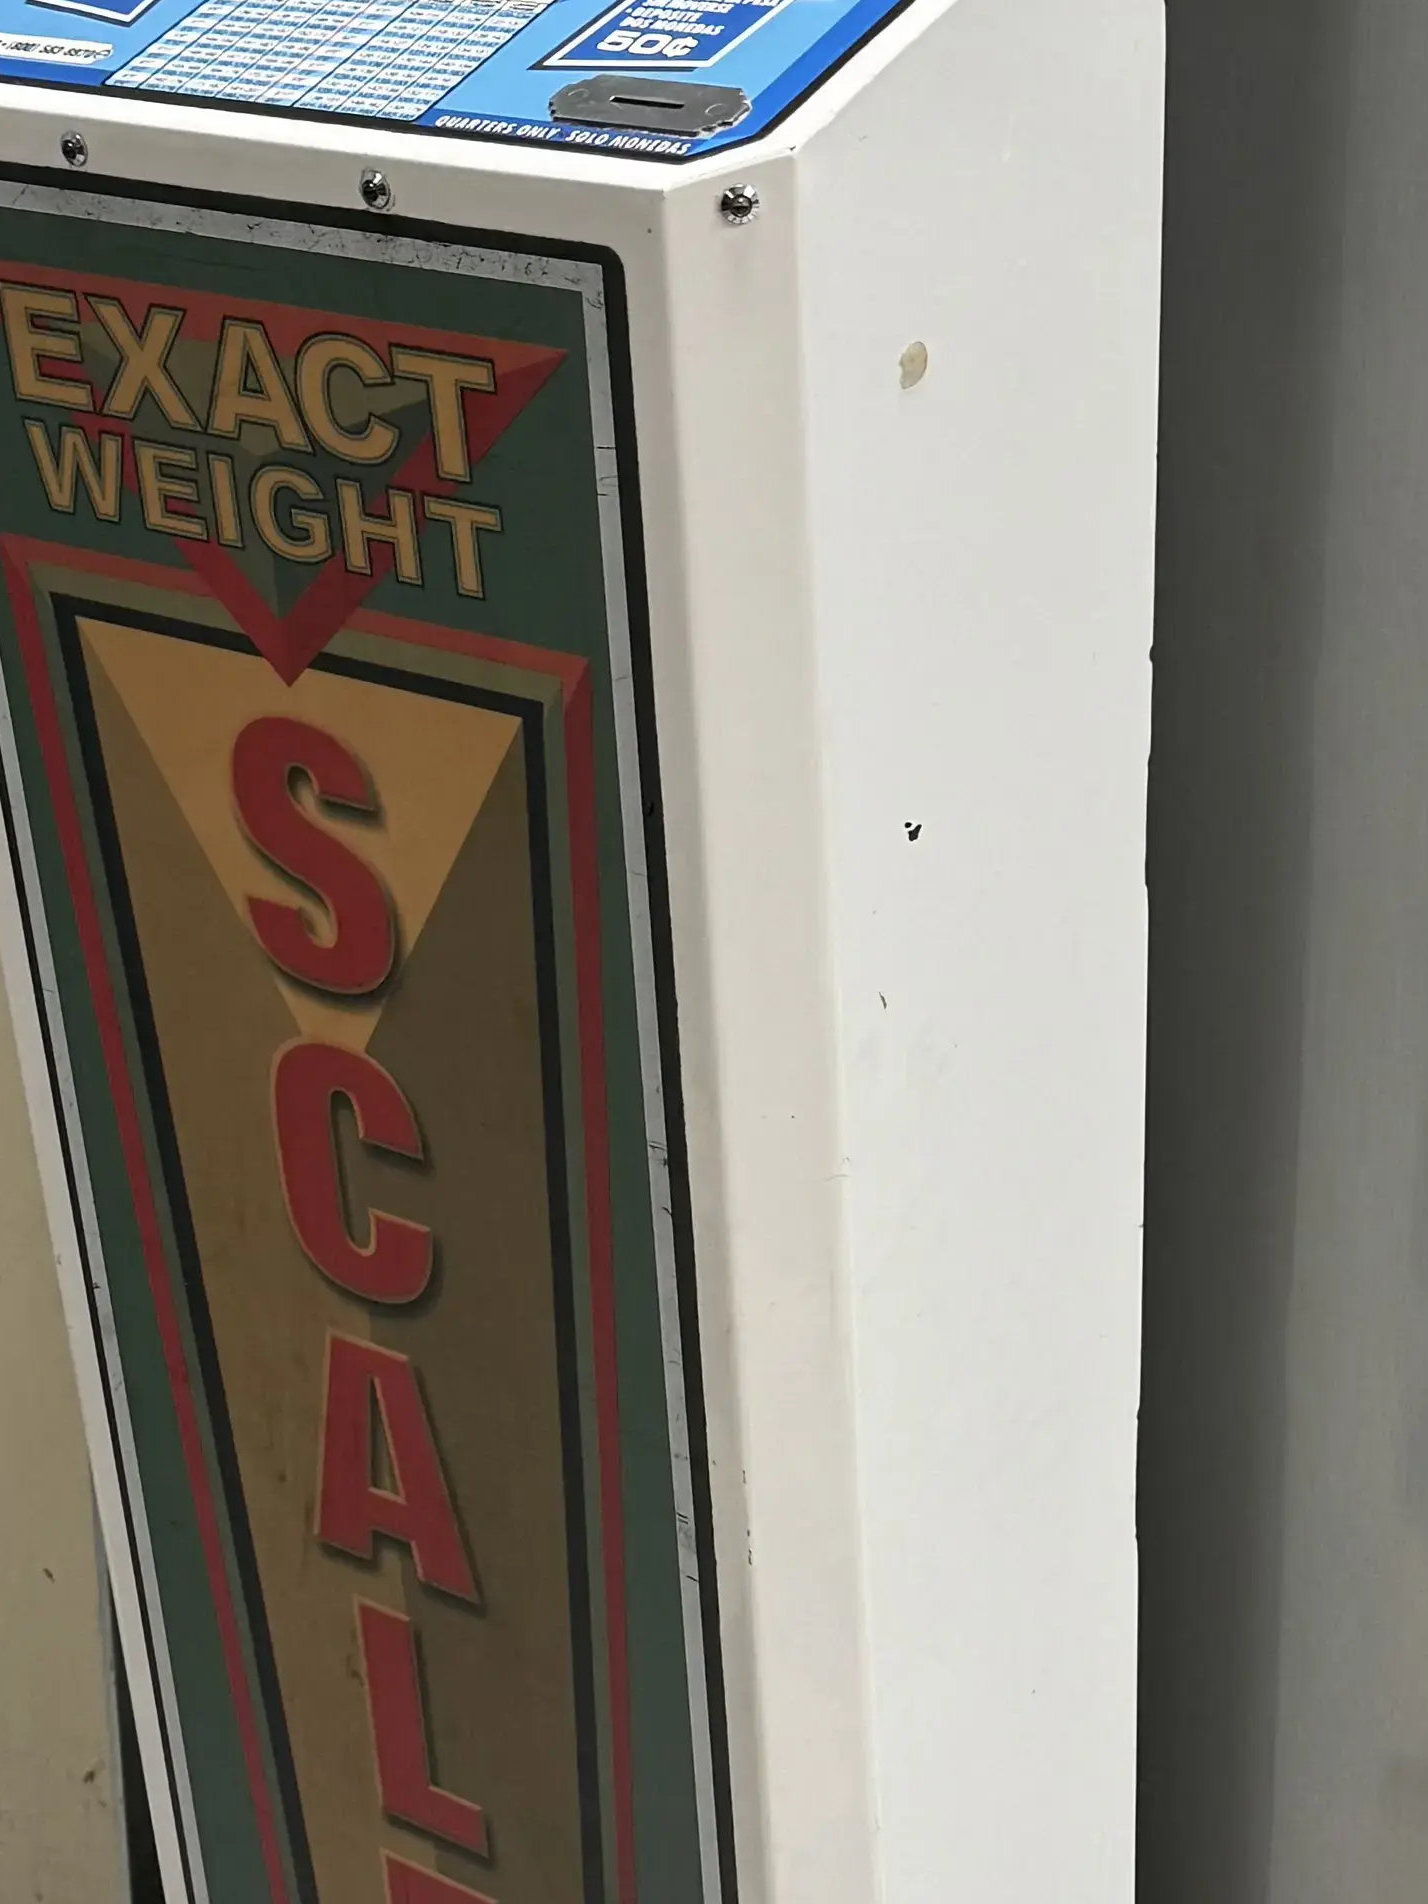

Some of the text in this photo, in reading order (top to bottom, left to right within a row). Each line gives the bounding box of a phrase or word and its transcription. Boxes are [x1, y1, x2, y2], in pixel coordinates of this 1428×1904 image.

[619, 16, 725, 36] DOS MONEDAS
[630, 7, 704, 23] DEPOSITE
[596, 29, 699, 58] 50¢
[434, 114, 692, 156] QUARTERS ONLY SOLO MONEDAS
[22, 417, 505, 601] WEIGHT
